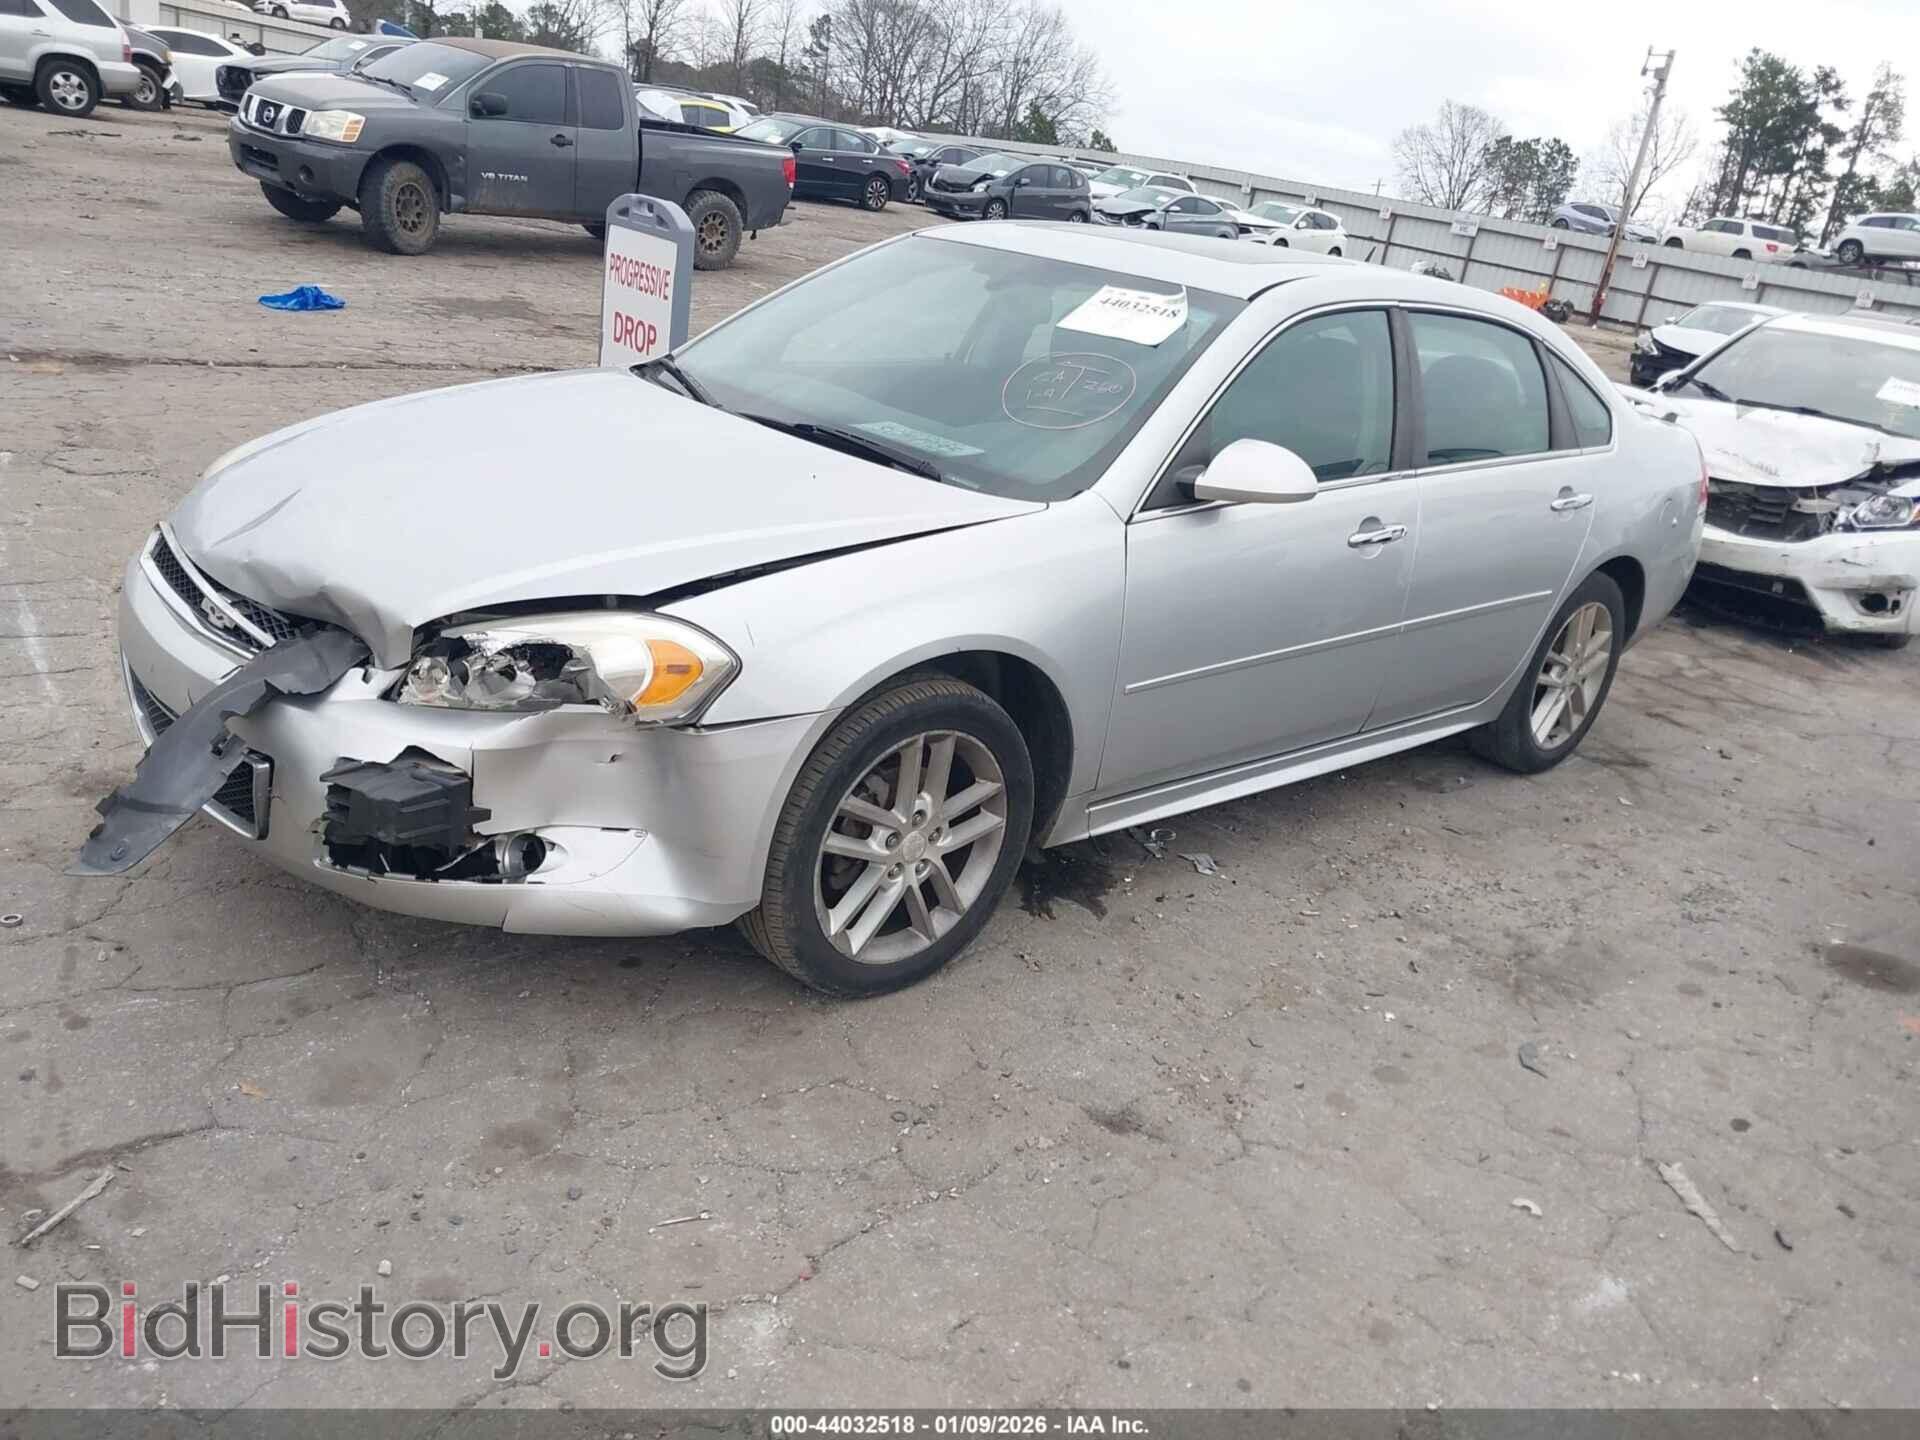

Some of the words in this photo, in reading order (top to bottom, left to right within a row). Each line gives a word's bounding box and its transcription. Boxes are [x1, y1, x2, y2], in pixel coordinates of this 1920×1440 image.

[497, 173, 528, 182] TITAN
[609, 252, 671, 301] PROGRESSIVE
[613, 311, 657, 356] DROP
